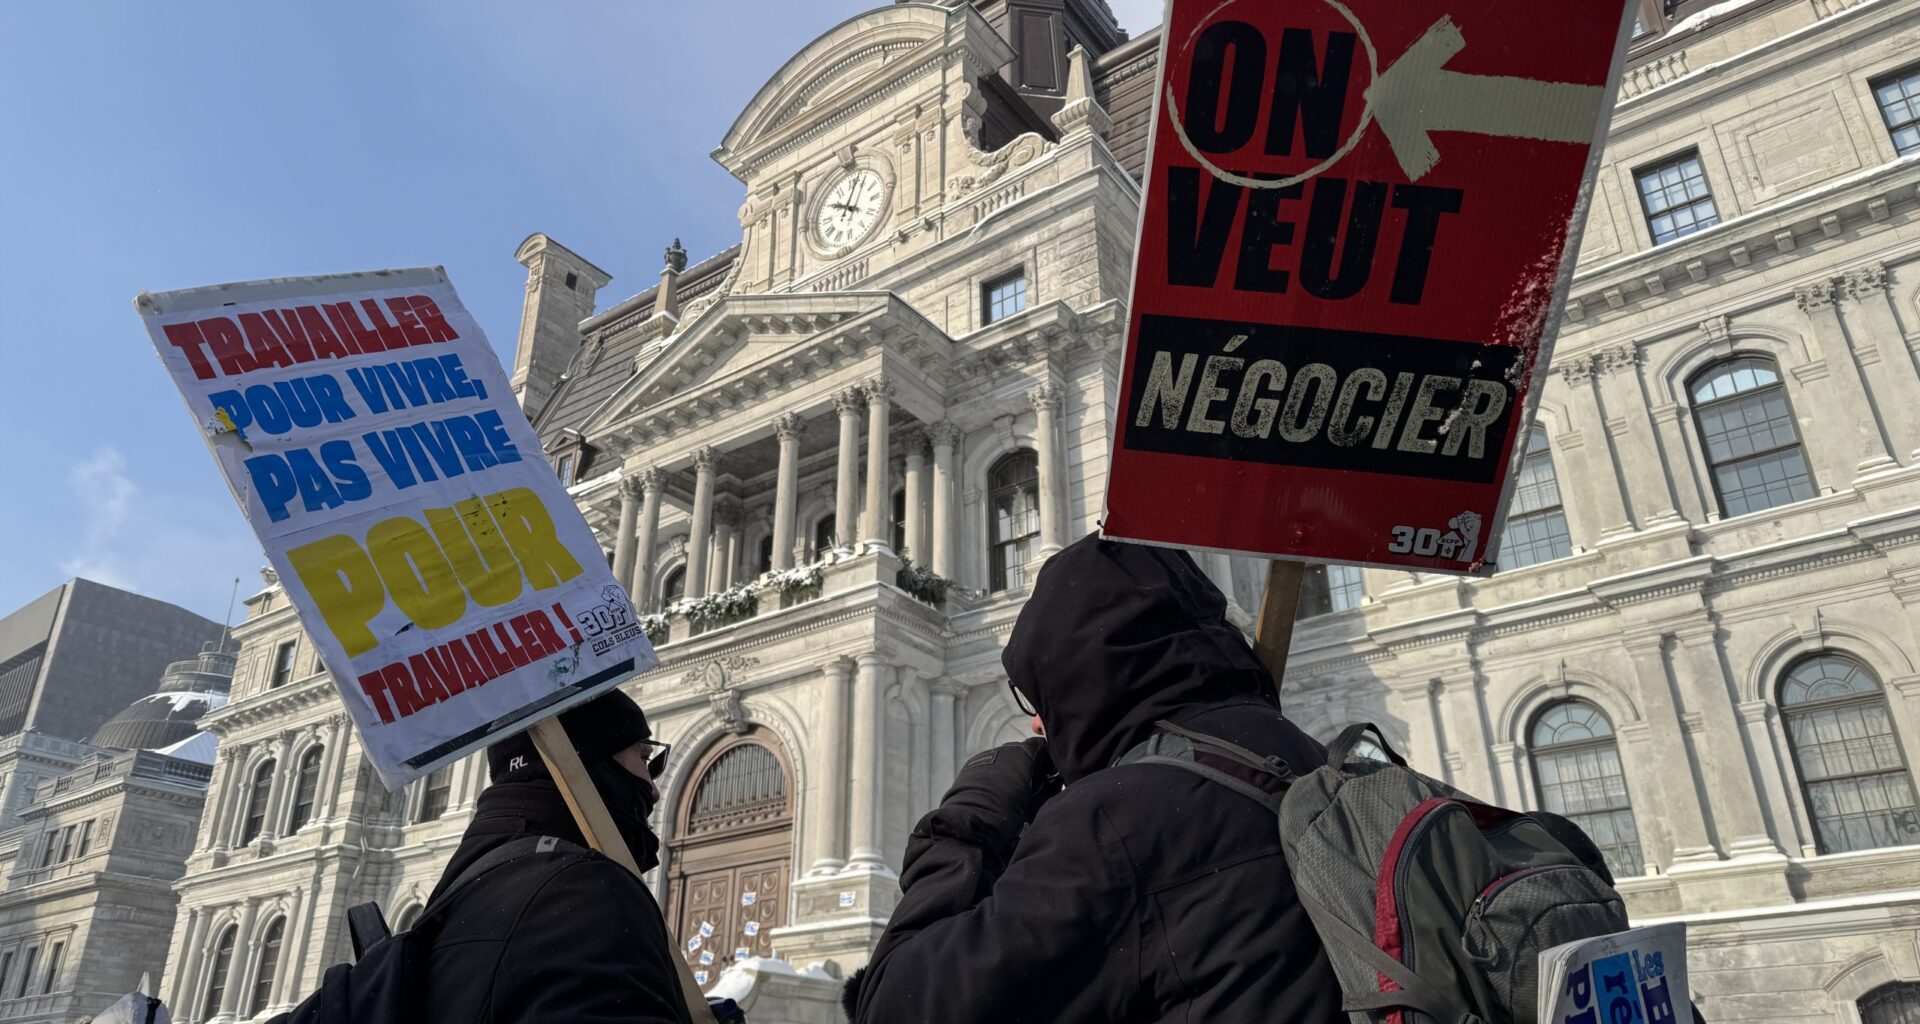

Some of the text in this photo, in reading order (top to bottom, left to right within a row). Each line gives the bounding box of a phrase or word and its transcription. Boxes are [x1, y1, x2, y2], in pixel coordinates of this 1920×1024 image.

[1184, 20, 1358, 160] ON
[1167, 165, 1465, 306] VEUT
[163, 295, 459, 380] TRAVAILLER
[208, 353, 489, 438] POUR VIVRE,
[1135, 334, 1507, 459] NÉGOCIER
[244, 409, 523, 523] PAS VIVRE
[286, 487, 585, 659] POUR
[358, 611, 568, 724] TRAVAILLER
[592, 637, 616, 653] COLS
[614, 626, 642, 643] BLEUS
[509, 755, 529, 773] RL
[1632, 949, 1665, 982] Les
